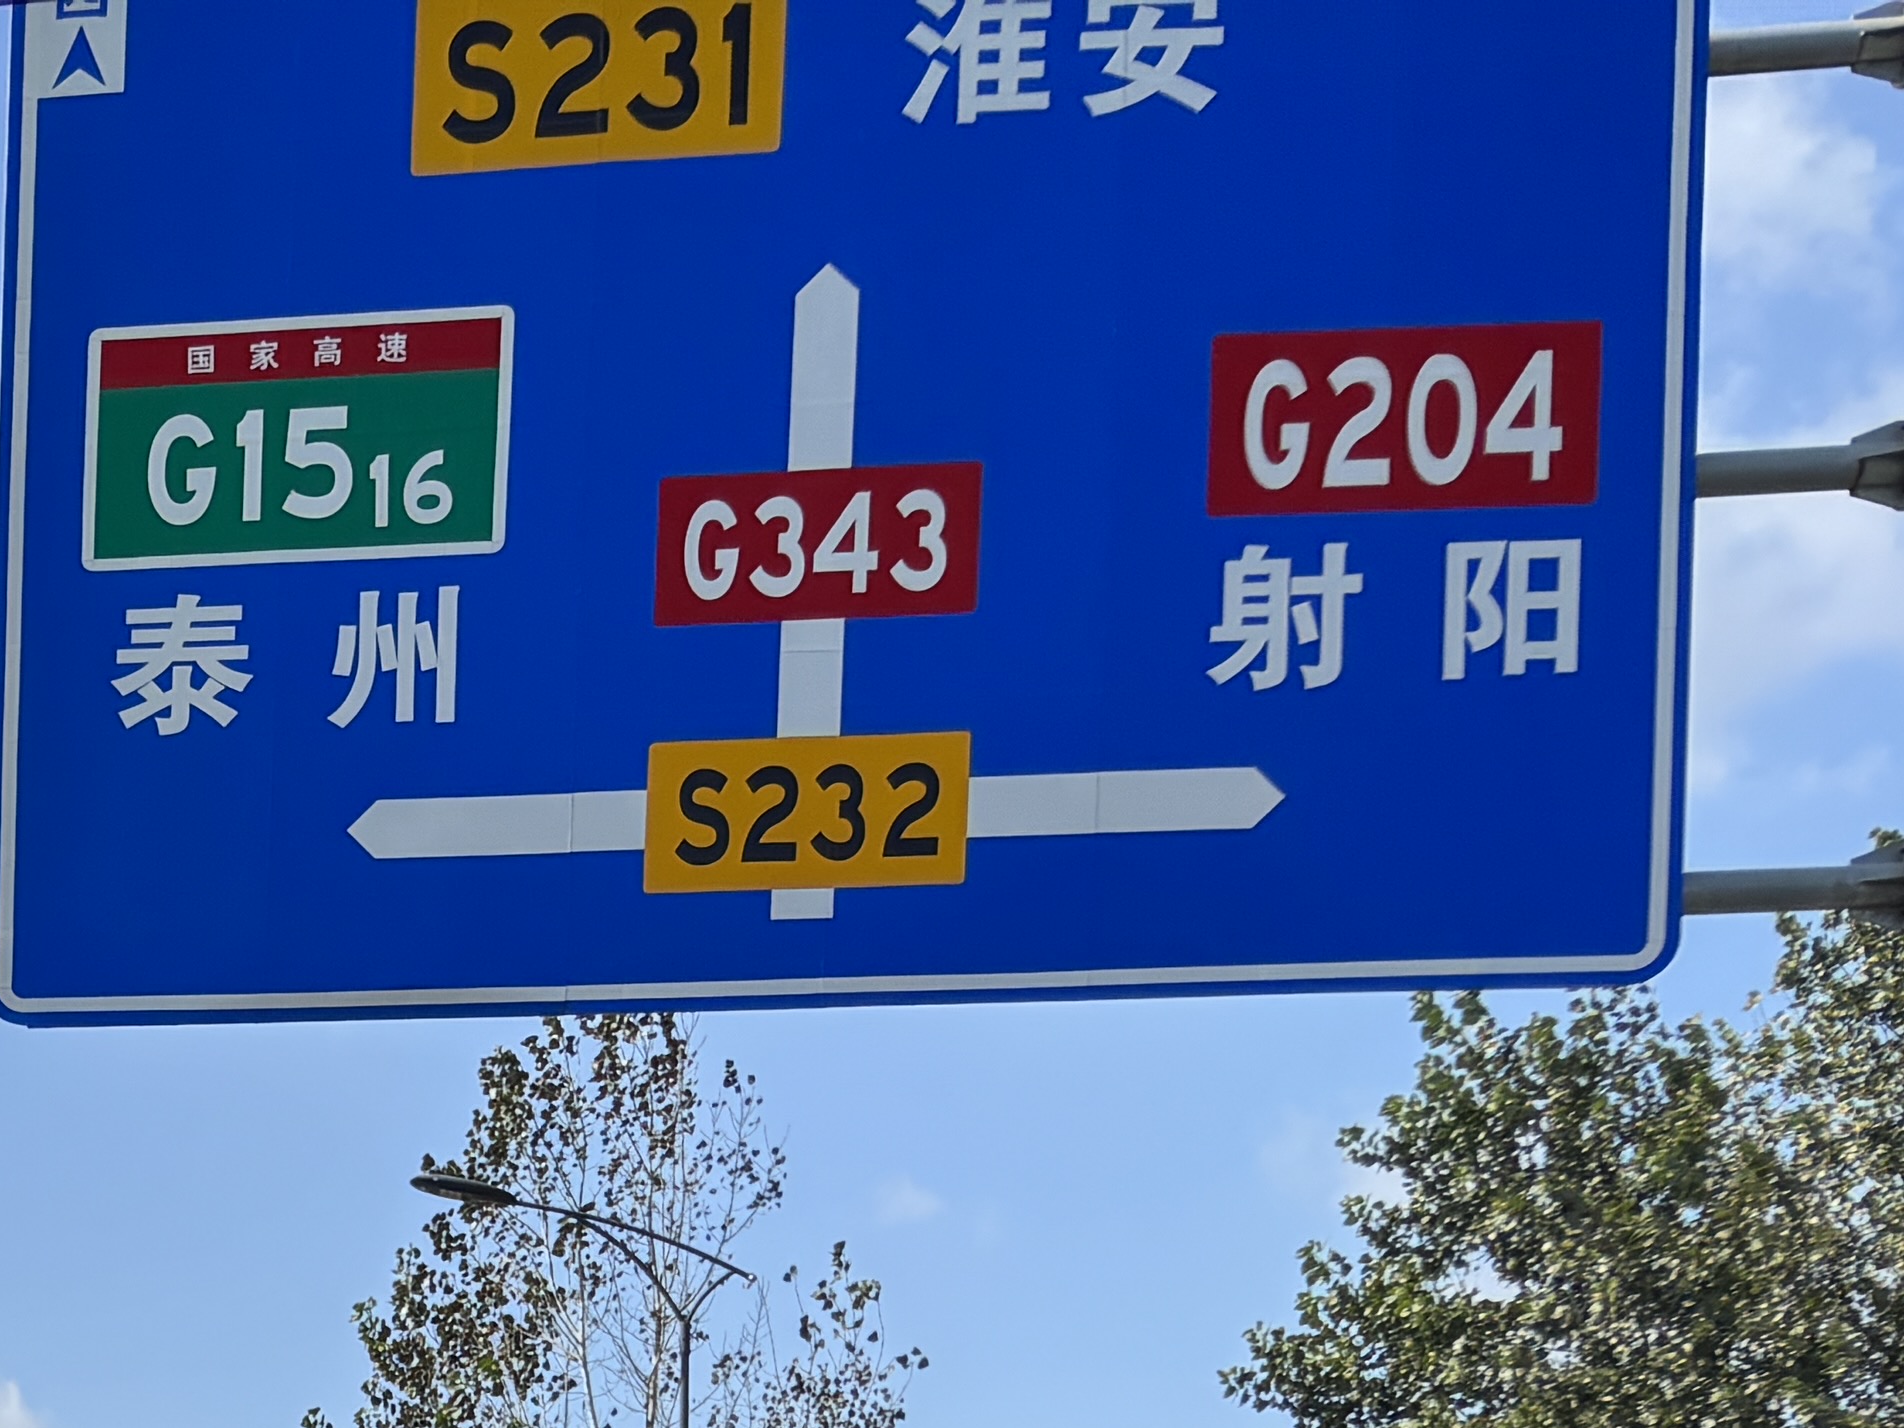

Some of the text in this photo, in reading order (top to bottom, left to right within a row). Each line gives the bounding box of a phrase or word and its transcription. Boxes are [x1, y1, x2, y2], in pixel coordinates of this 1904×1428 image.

[441, 2, 749, 144] S231
[901, 0, 1226, 126] 淮安
[186, 331, 409, 375] 国家高速
[147, 404, 454, 529] G1516
[1243, 349, 1563, 491] G204
[683, 488, 948, 601] G343
[110, 584, 461, 737] 泰州
[1204, 537, 1583, 692] 射阳
[674, 762, 940, 867] S232
